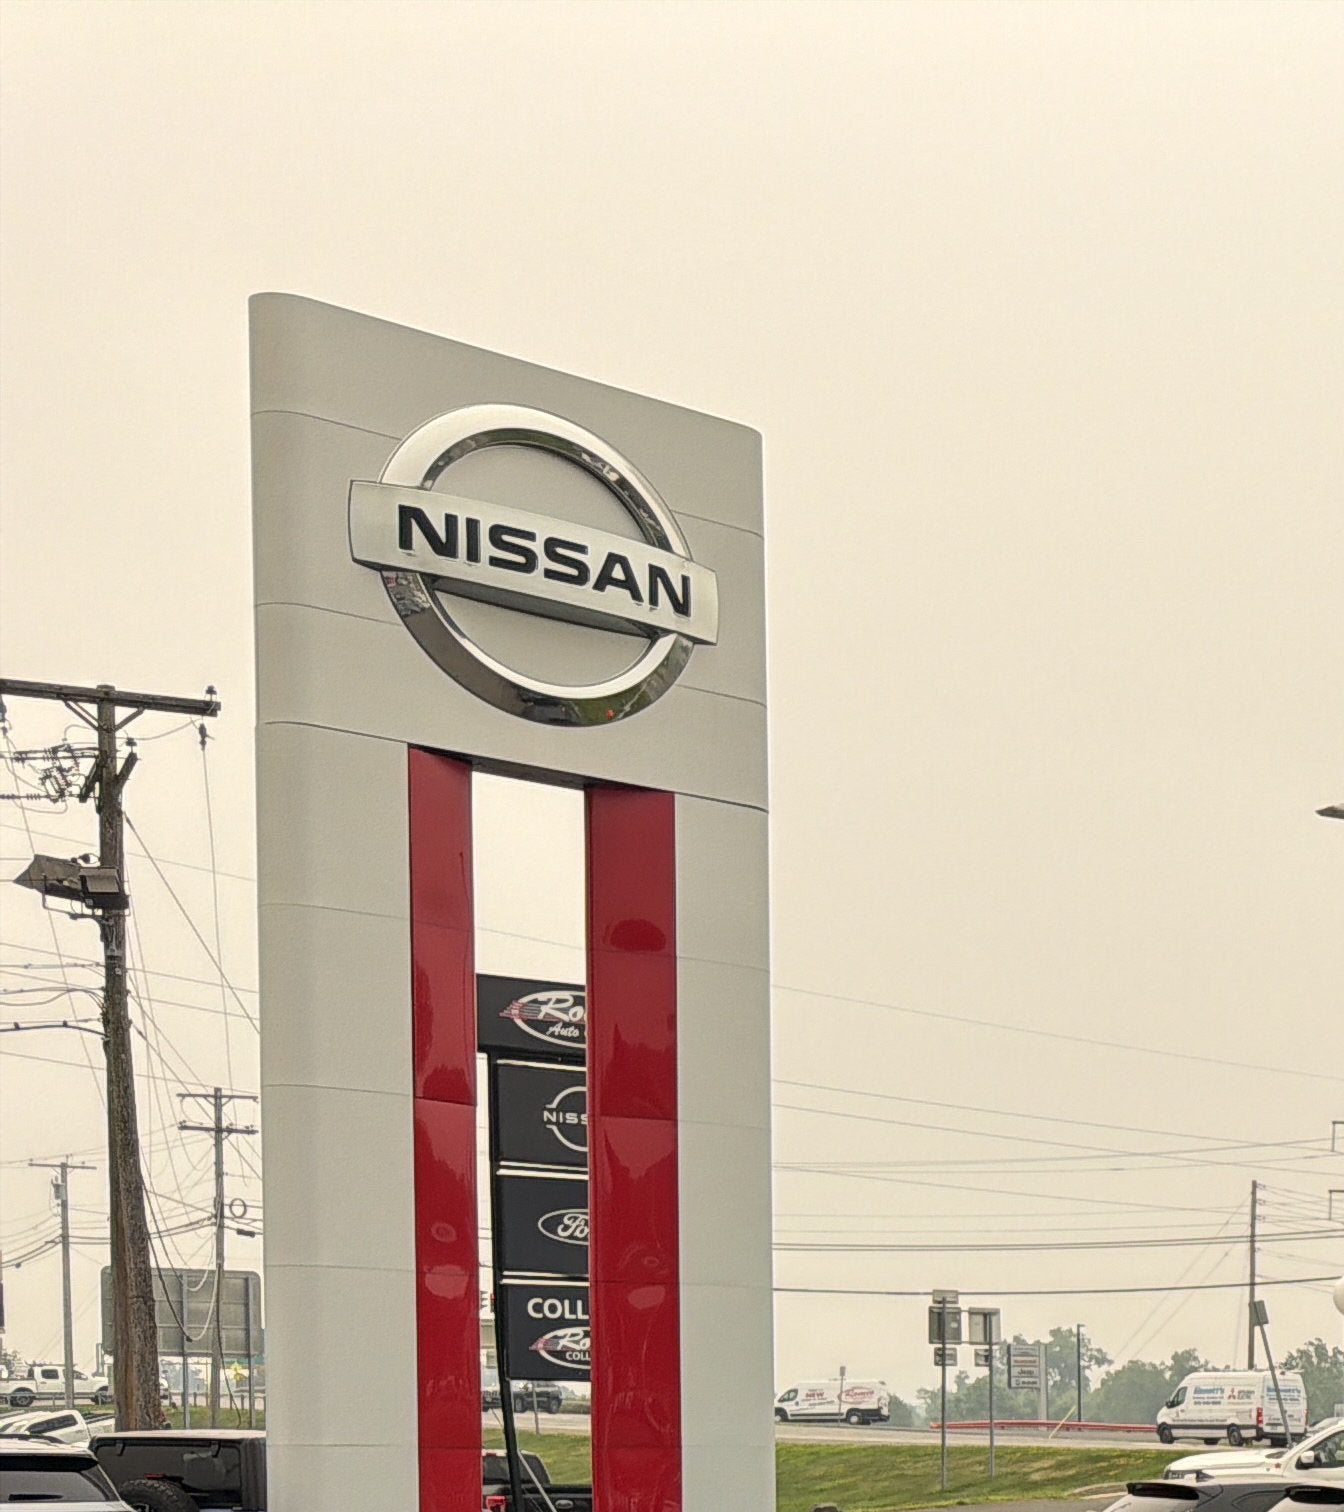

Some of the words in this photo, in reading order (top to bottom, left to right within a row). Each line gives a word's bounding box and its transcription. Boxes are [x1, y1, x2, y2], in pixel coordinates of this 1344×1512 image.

[398, 503, 692, 619] NISSAN
[537, 992, 587, 1022] Ro
[546, 1021, 580, 1037] Auto
[527, 1297, 590, 1320] COLL
